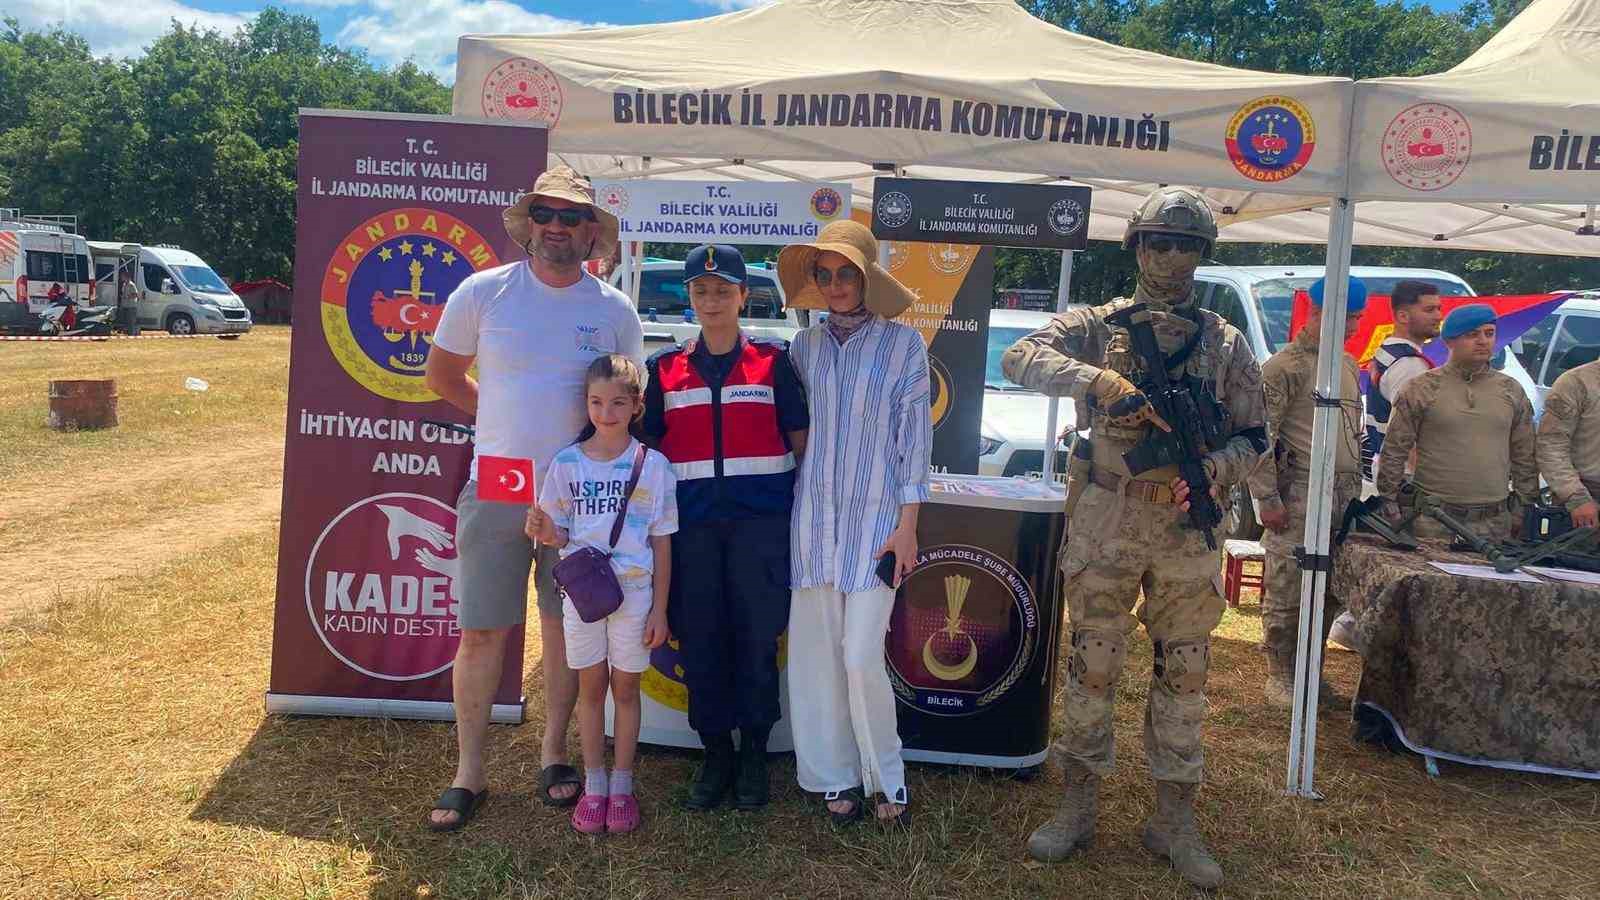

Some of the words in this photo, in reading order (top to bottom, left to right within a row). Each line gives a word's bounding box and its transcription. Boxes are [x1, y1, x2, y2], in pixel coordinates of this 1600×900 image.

[613, 89, 732, 126] BİLECİK
[740, 88, 766, 126] İL
[773, 93, 942, 132] JANDARMA
[950, 99, 1169, 152] KOMUTANLIĞI
[356, 156, 416, 177] BİLECİK
[420, 161, 487, 182] VALİLİĞİ
[312, 177, 325, 195] İL
[329, 181, 417, 201] JANDARMA
[706, 186, 731, 198] T.C.
[660, 202, 714, 216] BİLECİK
[718, 203, 777, 217] VALİLİĞİ
[944, 206, 977, 219] BİLECİK
[978, 207, 1014, 220] VALİLİĞİ
[620, 218, 632, 232] İL
[636, 221, 716, 234] JANDARMA
[719, 221, 818, 236] KOMUTANLIĞI
[919, 219, 928, 231] İL
[929, 221, 976, 233] JANDARMA
[977, 222, 1038, 236] KOMUTANLIĞI
[912, 317, 978, 332] KOMUTANLIĞI
[400, 352, 425, 363] 1839
[730, 390, 769, 398] JANDARMA
[300, 409, 414, 442] İHTİYACIN
[372, 452, 441, 477] ANDA
[324, 613, 388, 634] KADIN
[927, 695, 964, 707] BİLECİK
